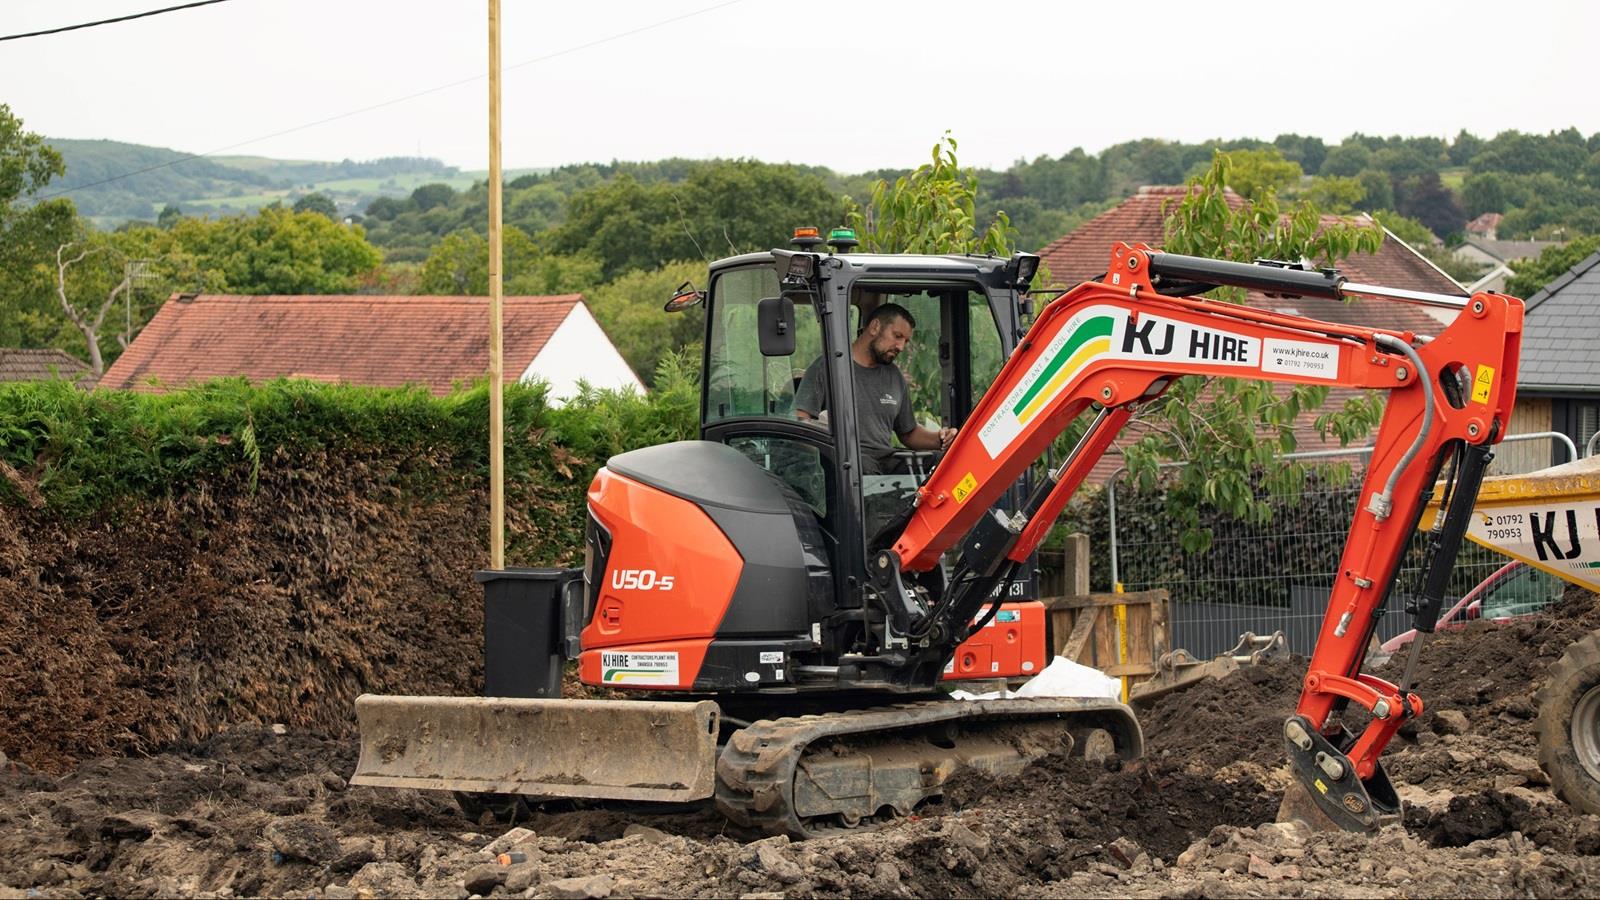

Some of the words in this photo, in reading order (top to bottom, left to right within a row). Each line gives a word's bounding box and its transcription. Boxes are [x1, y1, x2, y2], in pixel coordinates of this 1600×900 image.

[1122, 315, 1175, 355] KJ
[1188, 329, 1249, 362] HIRE
[1272, 347, 1329, 359] www.kjhire.co.uk
[1284, 359, 1301, 368] 01792
[1303, 361, 1324, 370] 790953
[983, 387, 1024, 437] CONTRACTORS
[1024, 364, 1043, 387] PLANT
[1051, 338, 1068, 353] TOOL
[1067, 317, 1082, 338] HIRE
[1496, 514, 1523, 525] 01792
[1487, 528, 1522, 539] 790953
[1529, 510, 1582, 561] KJ
[603, 654, 611, 667] KJ
[611, 654, 629, 667] HIRE
